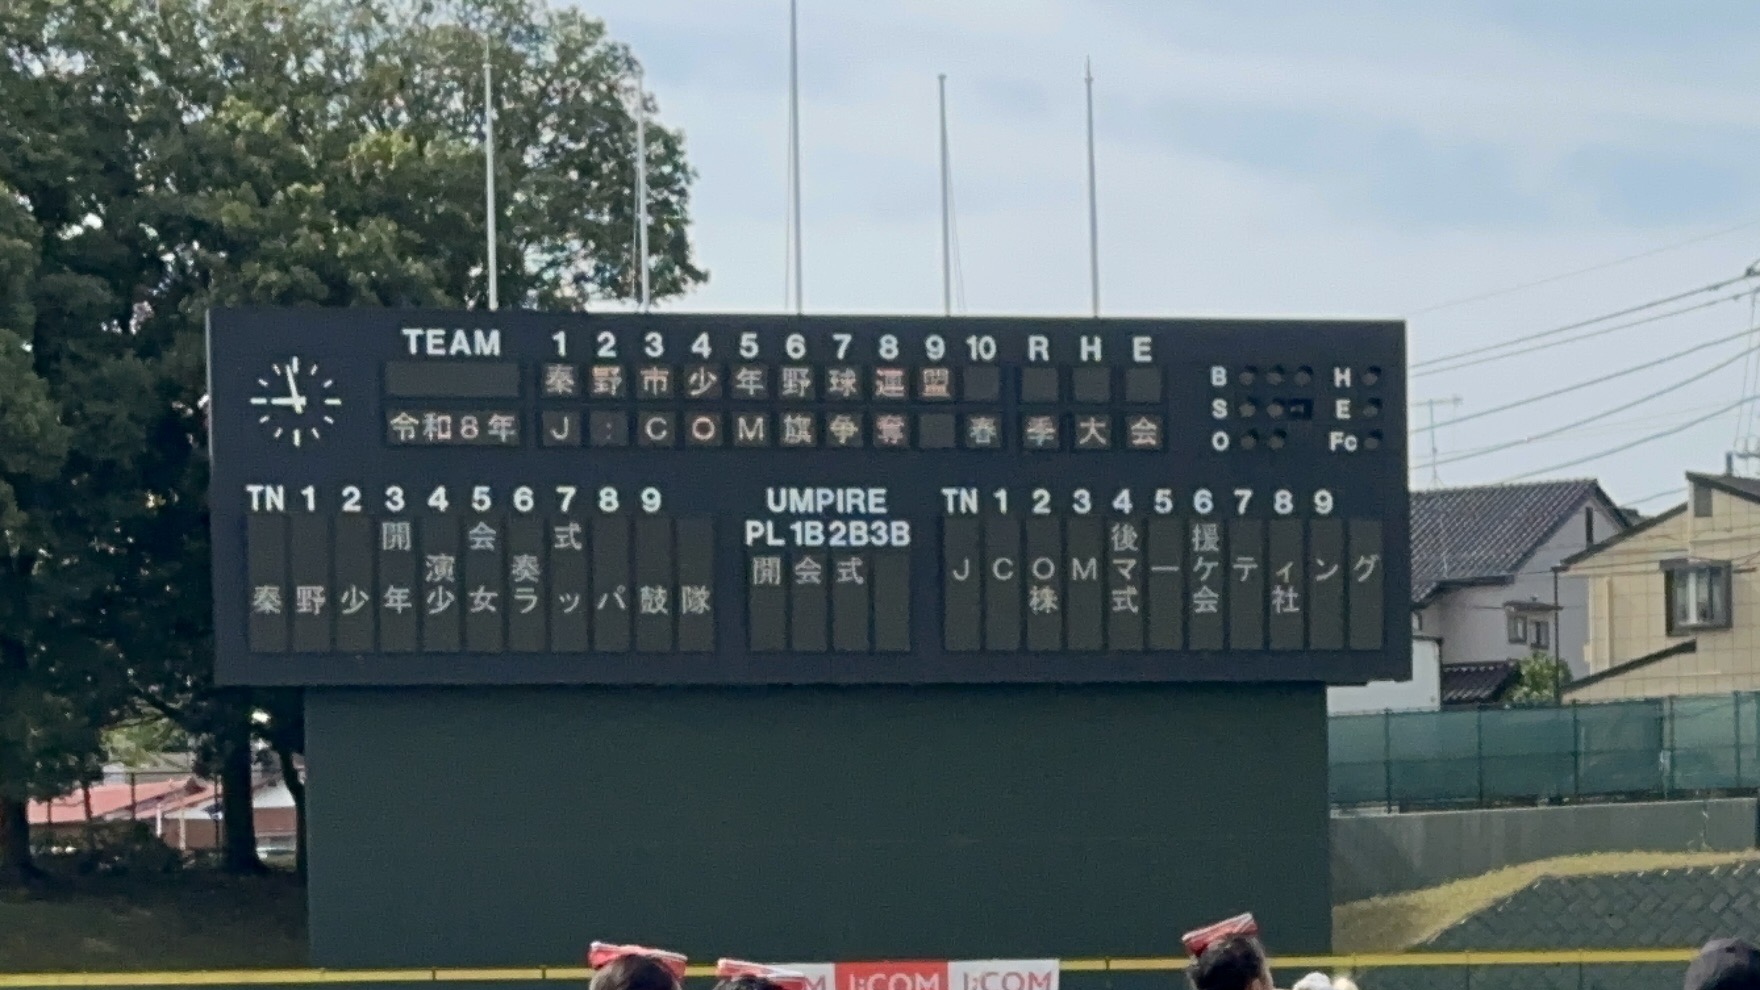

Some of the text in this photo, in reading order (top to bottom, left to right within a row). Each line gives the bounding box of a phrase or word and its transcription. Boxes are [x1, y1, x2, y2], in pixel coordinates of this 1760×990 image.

[402, 329, 1152, 362] TEAM 1 2 3 4 5 6 7 8 9 10 R H E
[1211, 366, 1226, 386] B
[1334, 367, 1351, 387] H
[1212, 399, 1227, 419] S
[1336, 399, 1350, 419] E
[1212, 431, 1229, 451] O
[246, 485, 661, 512] TN 1 2 3 4 5 6 7 8 9
[767, 488, 887, 513] UMPIRE
[942, 488, 1333, 514] TN 1 2 3 4 5 6 7 8 9
[746, 520, 910, 546] PL 1B 2B 3B
[752, 556, 865, 586] 開会式
